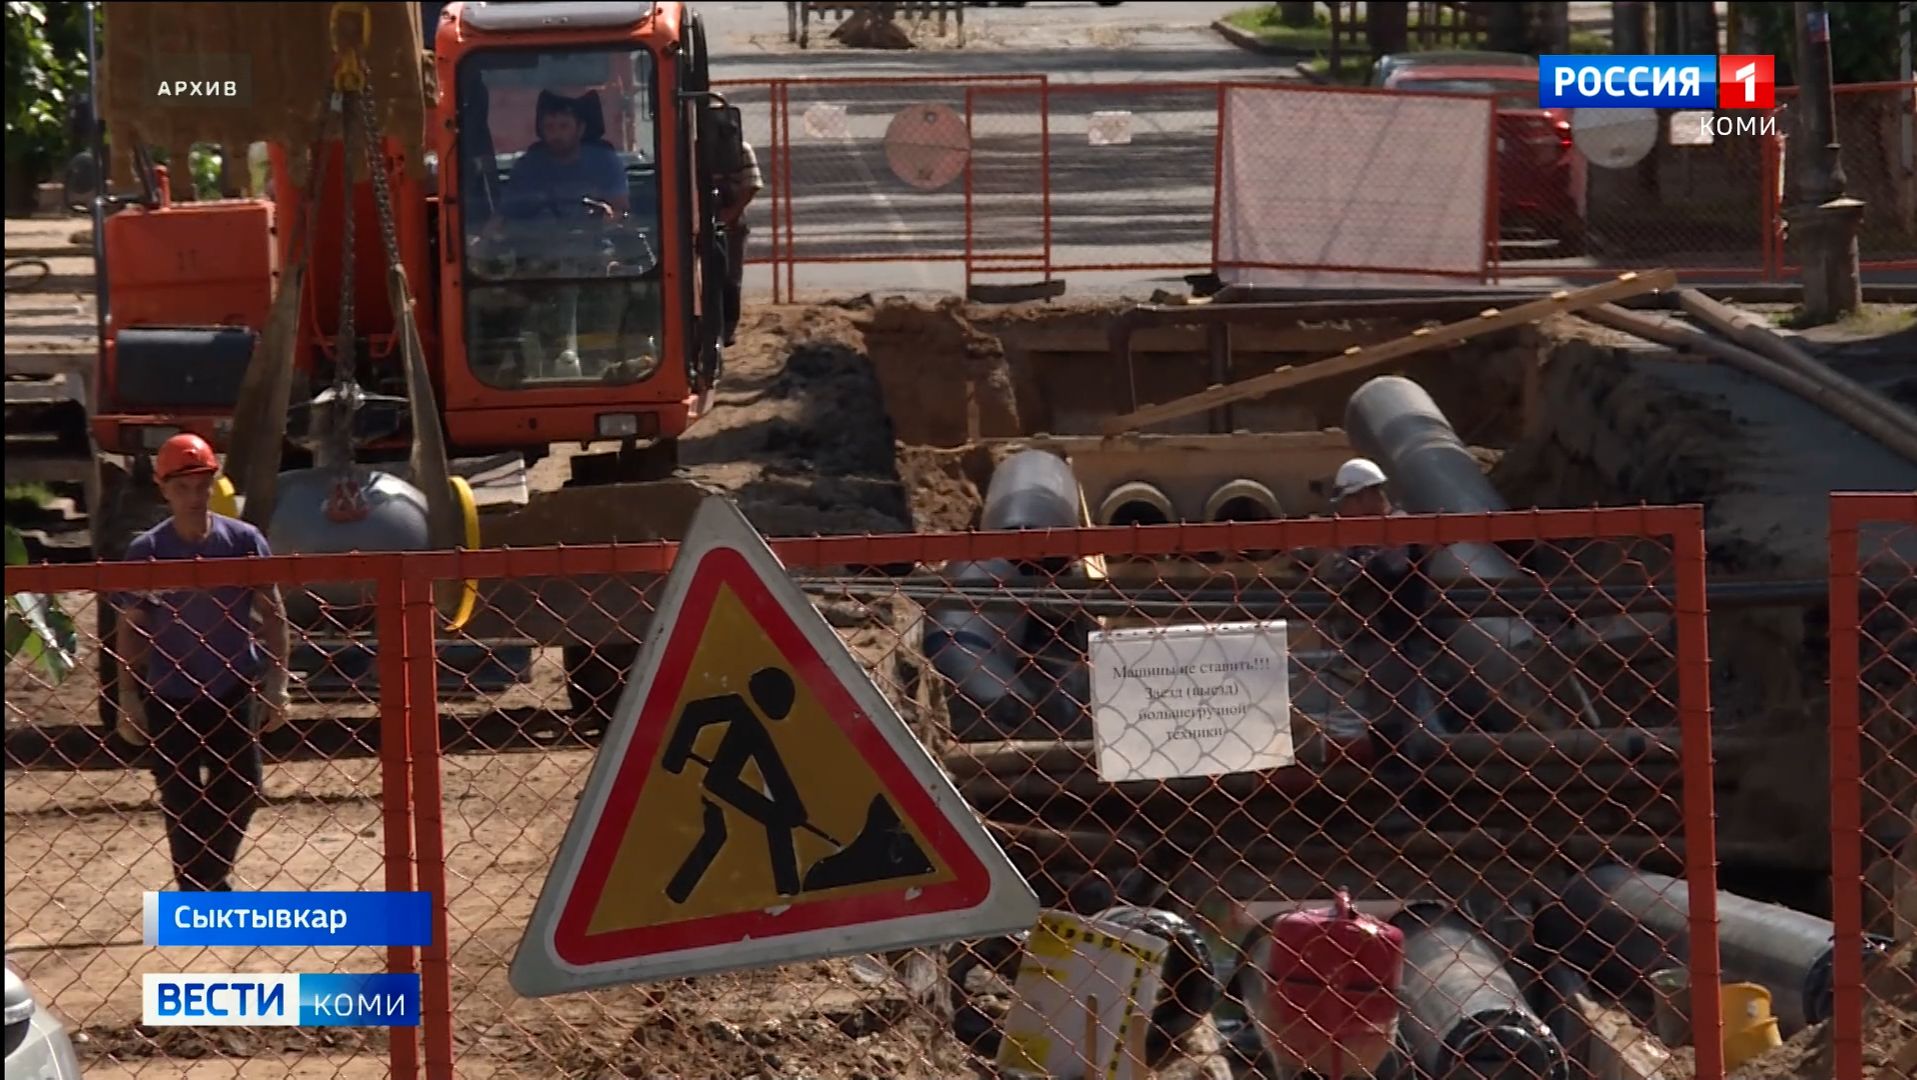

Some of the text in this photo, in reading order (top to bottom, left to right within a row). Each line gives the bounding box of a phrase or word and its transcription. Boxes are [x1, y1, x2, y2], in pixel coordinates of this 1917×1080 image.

[1113, 657, 1270, 679] Машины не ставить!!!
[1166, 727, 1224, 741] техники
